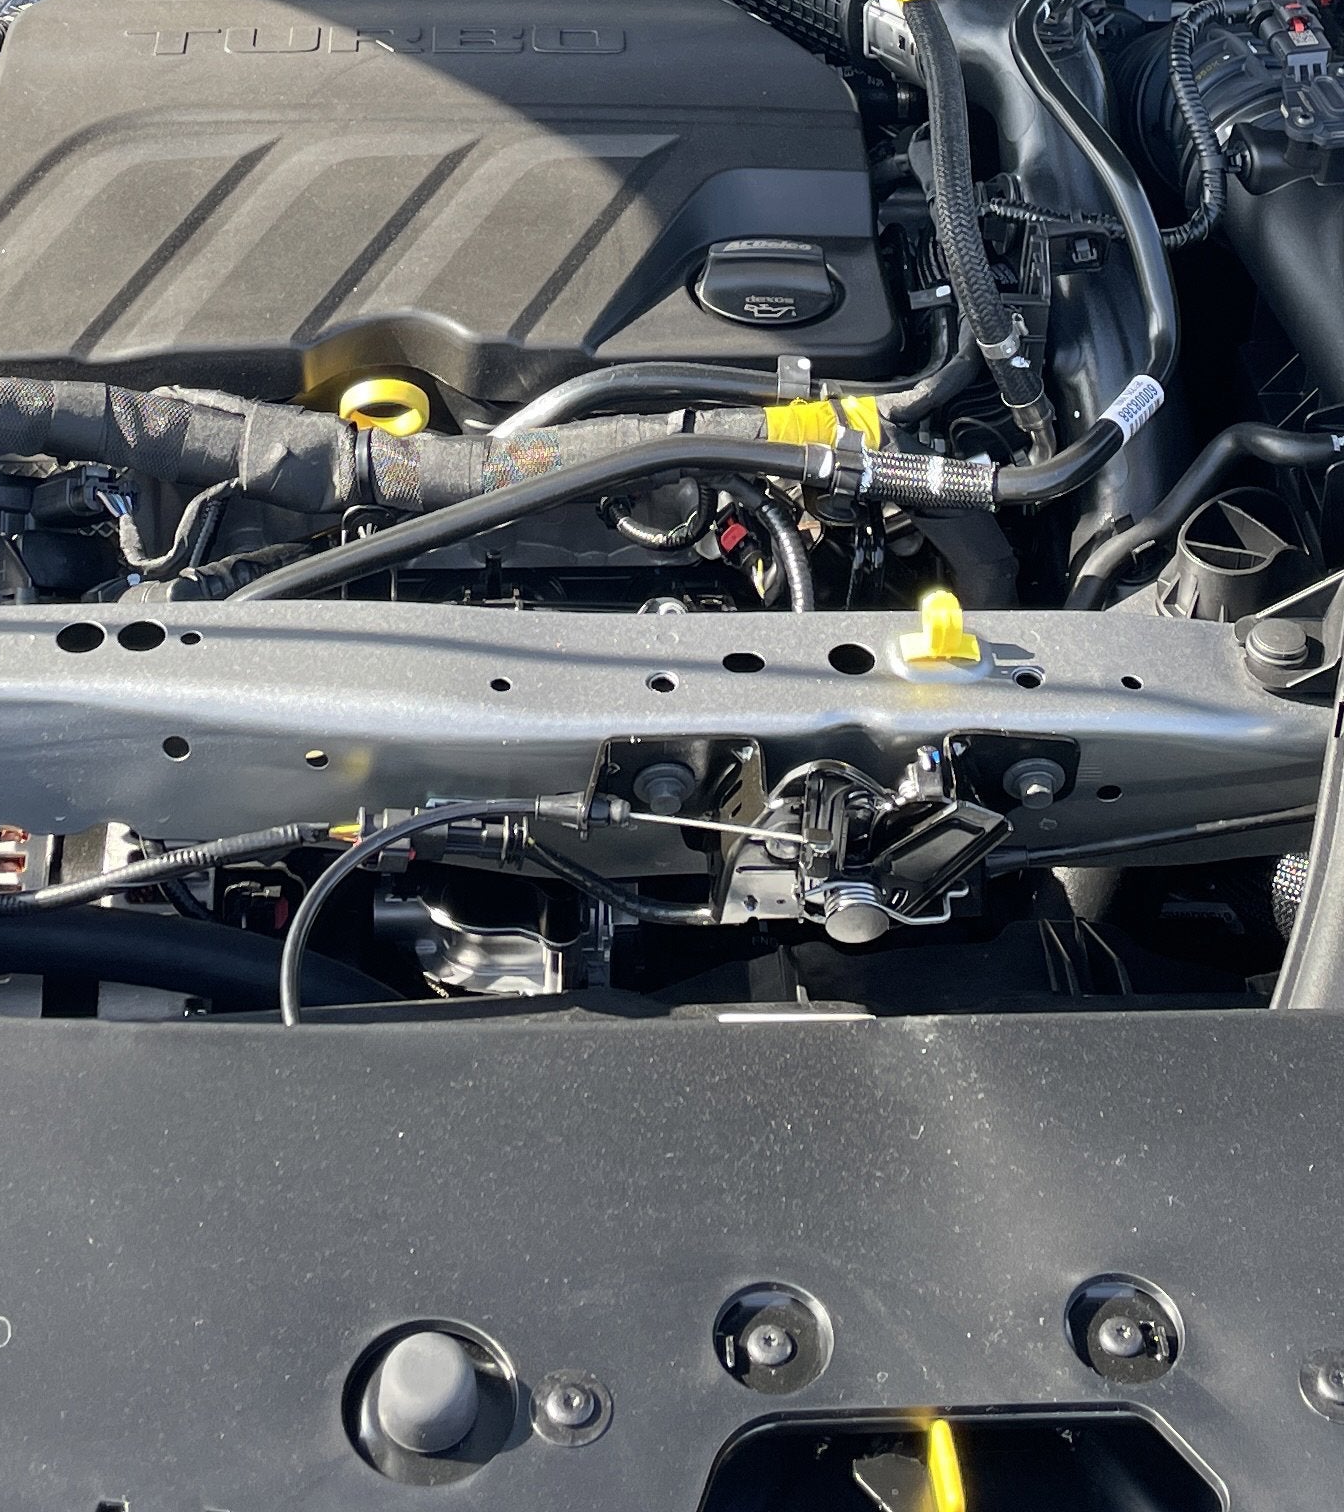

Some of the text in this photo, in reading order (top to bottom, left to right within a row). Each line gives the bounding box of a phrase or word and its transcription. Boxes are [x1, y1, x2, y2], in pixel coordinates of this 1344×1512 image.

[124, 26, 627, 55] TURBO
[722, 240, 813, 252] ACDelco
[744, 295, 795, 304] dexos
